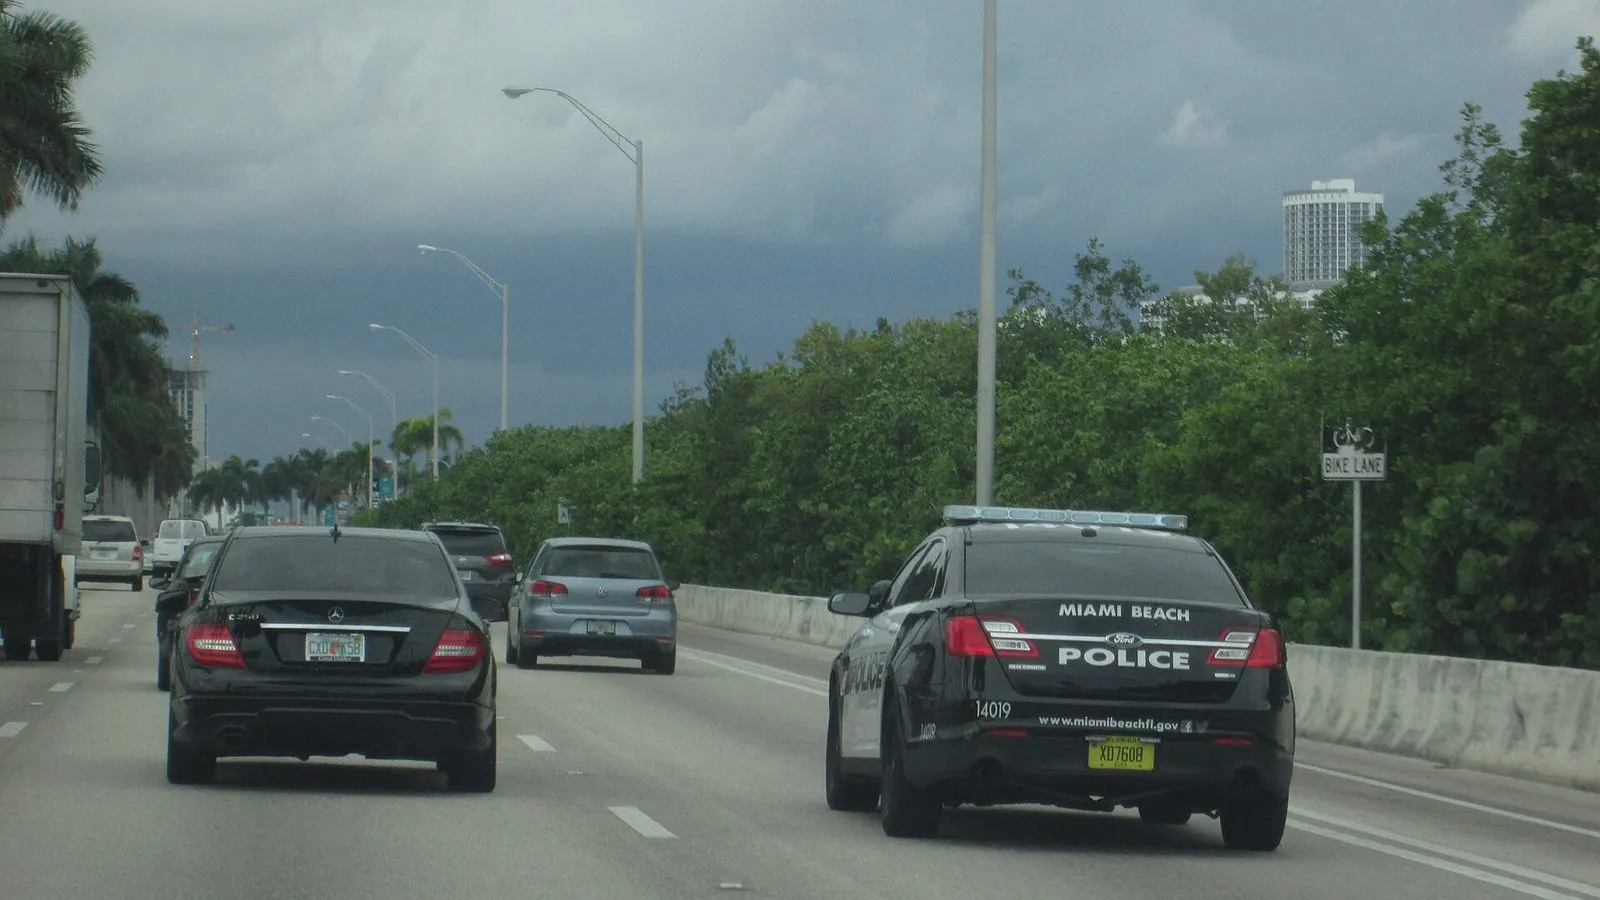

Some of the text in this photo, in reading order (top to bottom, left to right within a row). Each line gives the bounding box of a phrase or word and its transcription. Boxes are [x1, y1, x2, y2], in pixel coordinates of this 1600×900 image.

[1325, 457, 1382, 473] BIKE LANE
[1058, 603, 1190, 622] MIAMI BEACH
[1113, 634, 1135, 644] Ford
[1058, 647, 1190, 670] POLICE
[975, 700, 1011, 719] 14019
[1038, 715, 1179, 733] www.miamibeachfl.gov
[1099, 744, 1144, 763] XD7608
